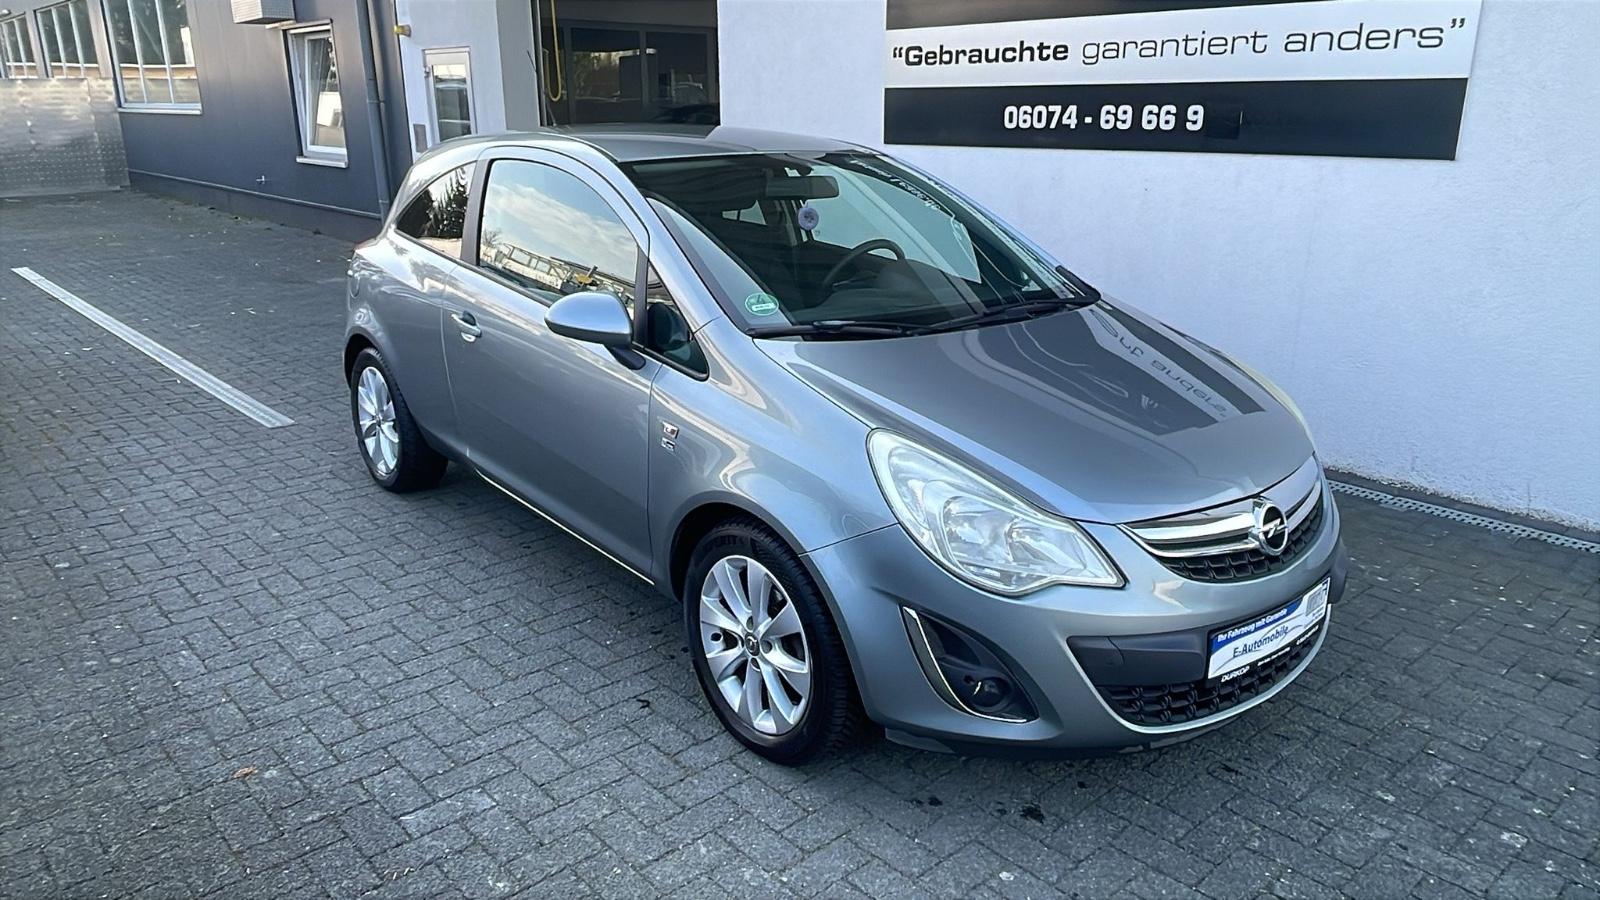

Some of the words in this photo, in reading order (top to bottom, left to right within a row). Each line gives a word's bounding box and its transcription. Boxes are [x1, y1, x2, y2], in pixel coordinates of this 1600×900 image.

[1082, 30, 1268, 65] garantiert
[1003, 104, 1078, 130] 06074
[1099, 104, 1133, 130] 69
[1141, 104, 1177, 131] 66
[1185, 104, 1205, 131] 9
[1233, 625, 1289, 658] E-Automobile
